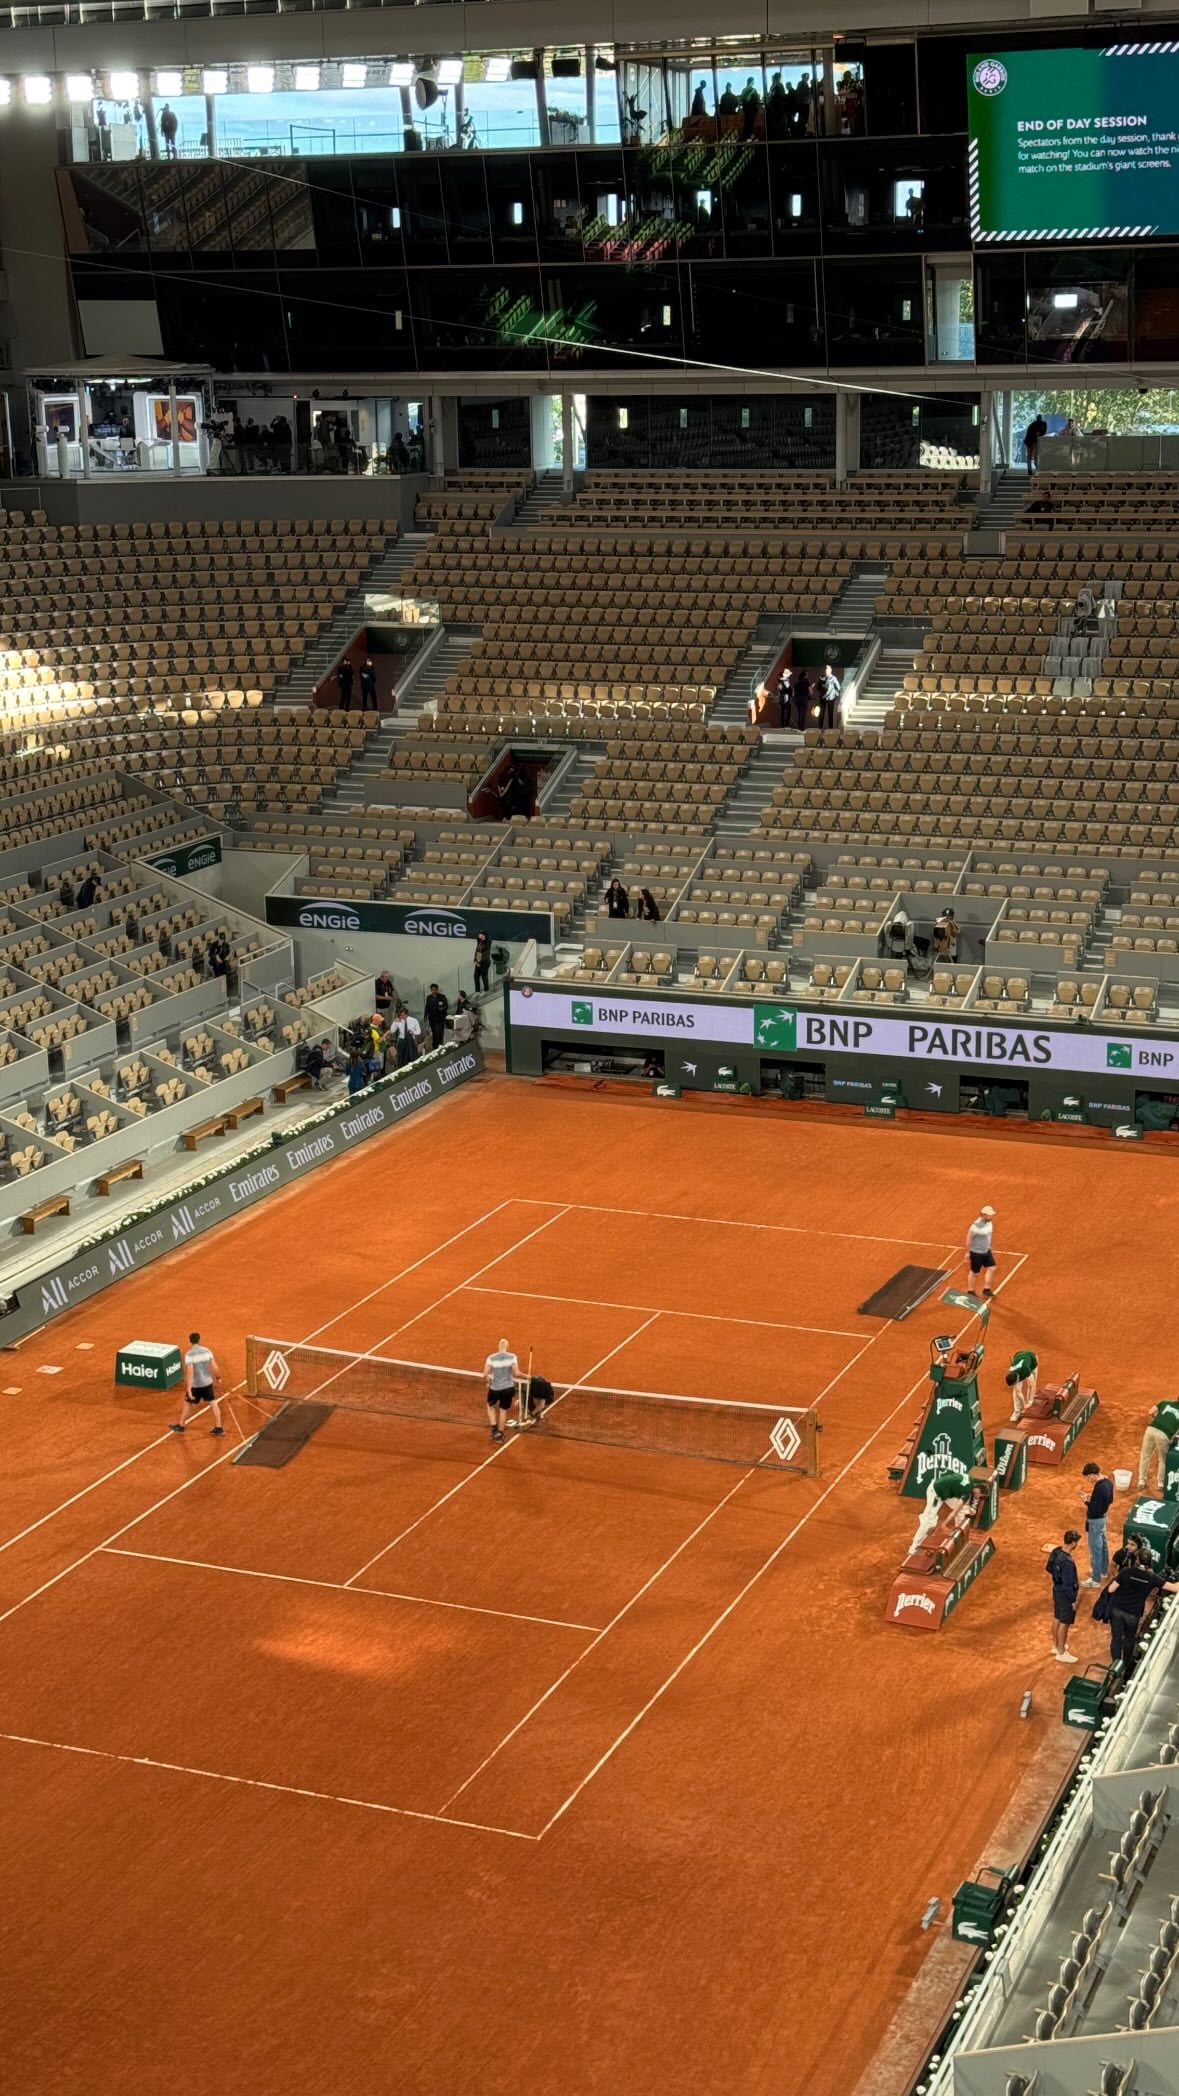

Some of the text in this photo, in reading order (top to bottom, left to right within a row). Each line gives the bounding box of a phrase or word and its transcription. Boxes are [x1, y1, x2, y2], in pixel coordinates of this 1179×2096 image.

[1017, 115, 1147, 132] END OF DAY SESSION
[1017, 138, 1061, 148] Spectators
[1062, 136, 1083, 145] from
[1084, 136, 1098, 144] the
[1100, 135, 1116, 145] day
[1117, 133, 1150, 143] session,
[1152, 131, 1176, 141] thank
[1018, 151, 1029, 160] for
[1030, 150, 1070, 161] watching!
[1072, 149, 1089, 158] You
[1090, 149, 1106, 157] can
[1107, 149, 1126, 157] now
[1127, 146, 1153, 156] watch
[1154, 146, 1170, 155] the
[1018, 160, 1172, 174] match on the stadium's giant screens.
[598, 1008, 695, 1028] BNP PARIBAS
[805, 1017, 1052, 1064] BNP PARIBAS
[437, 1053, 476, 1085] Emirates
[1138, 1050, 1175, 1067] BNP
[389, 1079, 433, 1112] Emirates
[339, 1105, 385, 1140] Emirates
[286, 1133, 335, 1170] Emirates
[228, 1163, 280, 1202] Emirates
[194, 1197, 222, 1219] ACCOR
[133, 1229, 164, 1254] ACCOR
[68, 1265, 100, 1291] ACCOR
[121, 1362, 159, 1379] Haier
[1027, 1433, 1056, 1452] errier
[894, 1592, 936, 1617] Perrier
